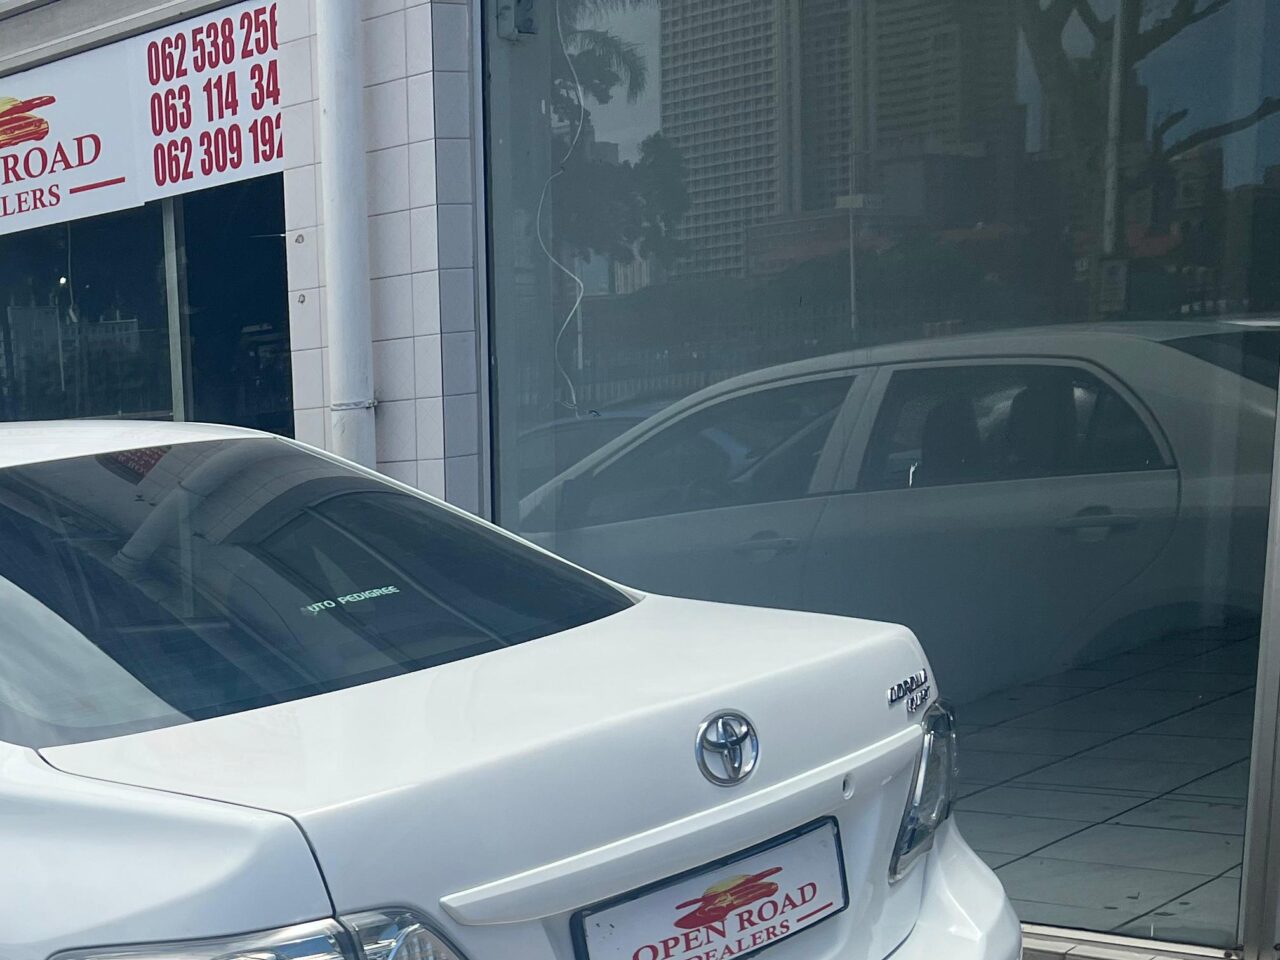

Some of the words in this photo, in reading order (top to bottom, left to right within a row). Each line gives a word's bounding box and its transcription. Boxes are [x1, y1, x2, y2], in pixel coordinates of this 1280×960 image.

[147, 33, 188, 86] 062
[192, 17, 235, 73] 538
[150, 84, 192, 137] 063
[203, 71, 239, 122] 114
[0, 133, 101, 185] ROAD
[153, 136, 194, 187] 062
[199, 123, 242, 176] 309
[301, 600, 336, 614] UTO
[337, 585, 400, 604] PEDIGREE
[736, 882, 818, 932] ROAD
